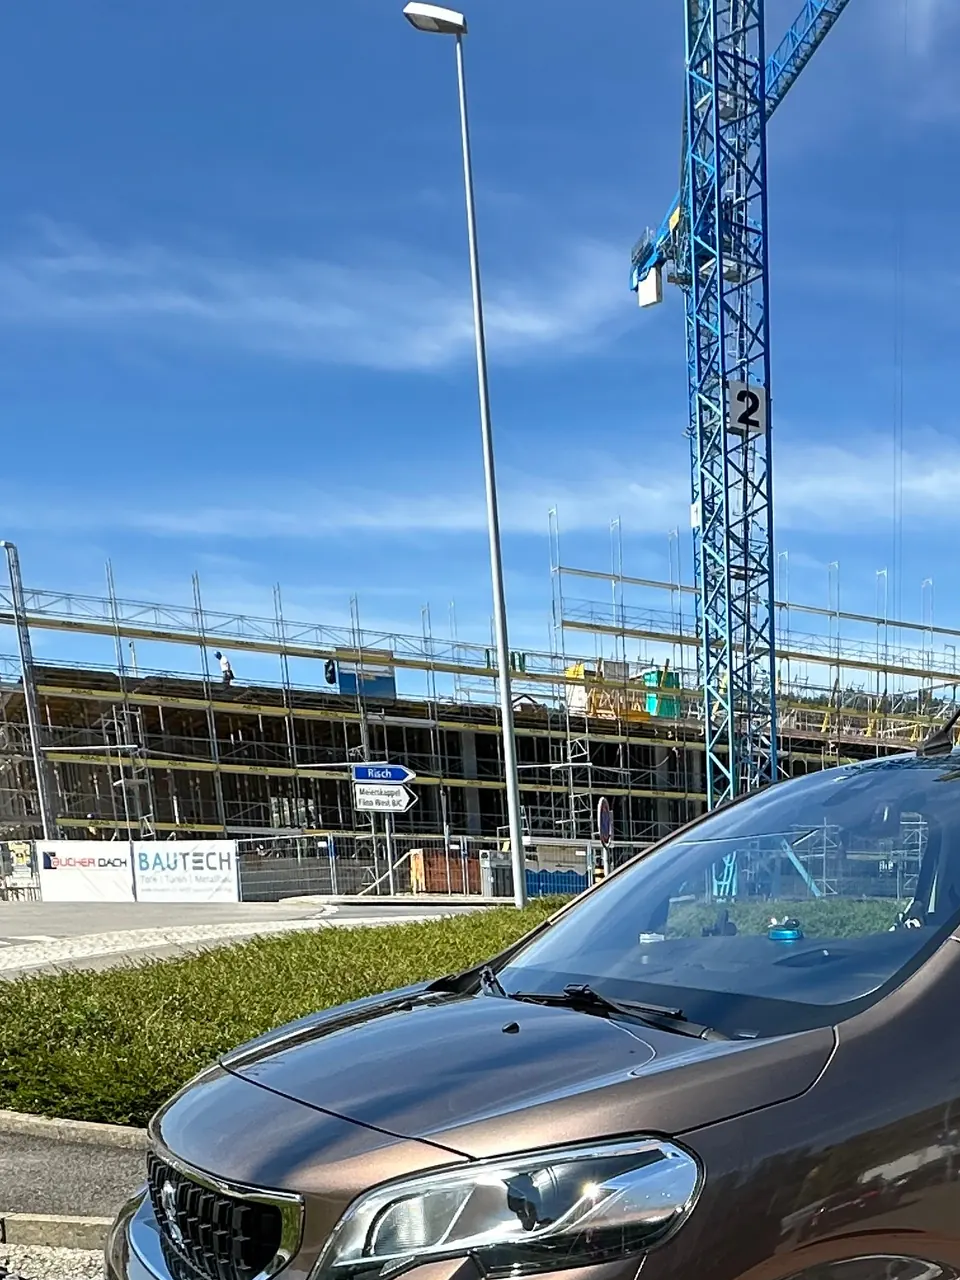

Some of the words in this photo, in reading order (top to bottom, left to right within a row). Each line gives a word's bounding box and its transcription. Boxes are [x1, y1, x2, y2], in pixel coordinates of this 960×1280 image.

[736, 389, 760, 428] 2
[367, 768, 392, 779] Risch
[98, 858, 128, 868] DACH
[138, 851, 232, 872] BAUTECH
